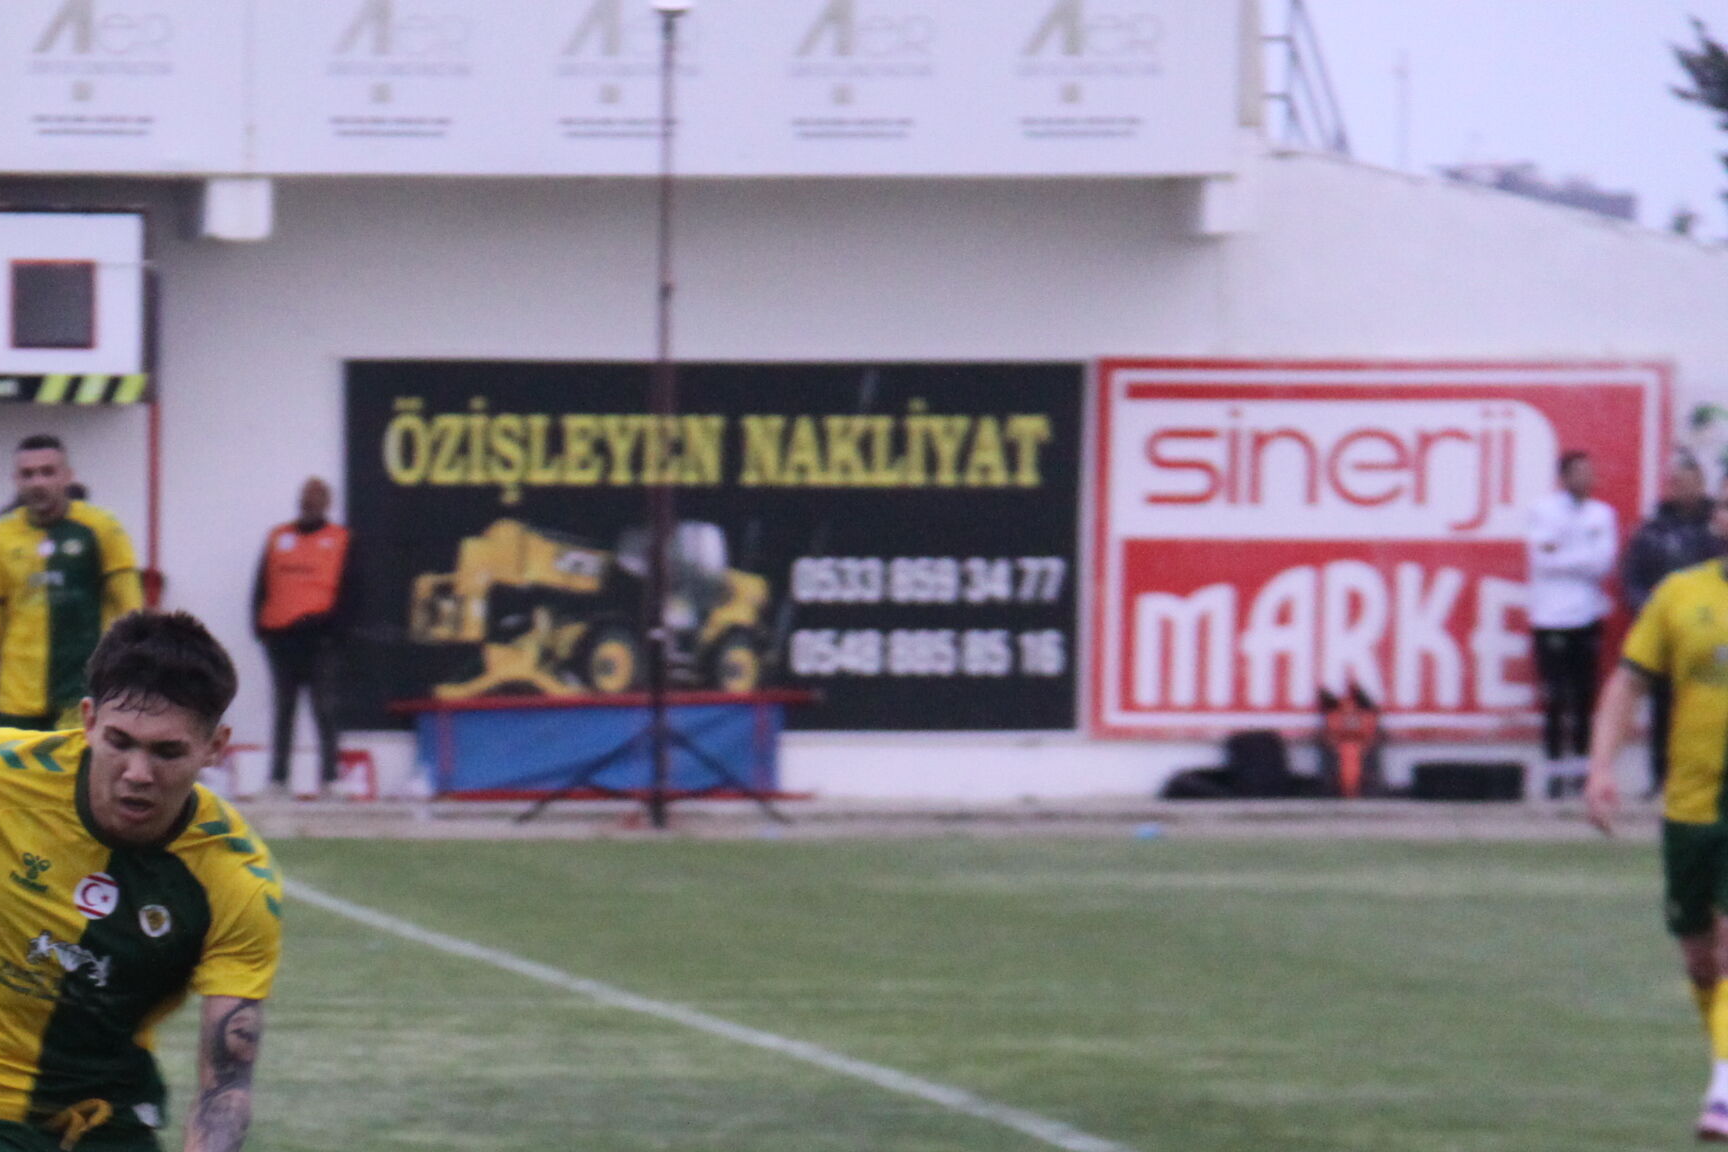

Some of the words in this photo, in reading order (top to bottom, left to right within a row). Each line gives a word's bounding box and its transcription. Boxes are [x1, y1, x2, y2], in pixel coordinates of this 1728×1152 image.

[384, 397, 725, 504] ÖZİŞLEYEN
[739, 397, 1052, 487] NAKLİYAT
[1145, 407, 1518, 532] sinerji
[962, 555, 1013, 602] 34
[1016, 556, 1067, 601] 77
[1135, 560, 1534, 710] MARKE
